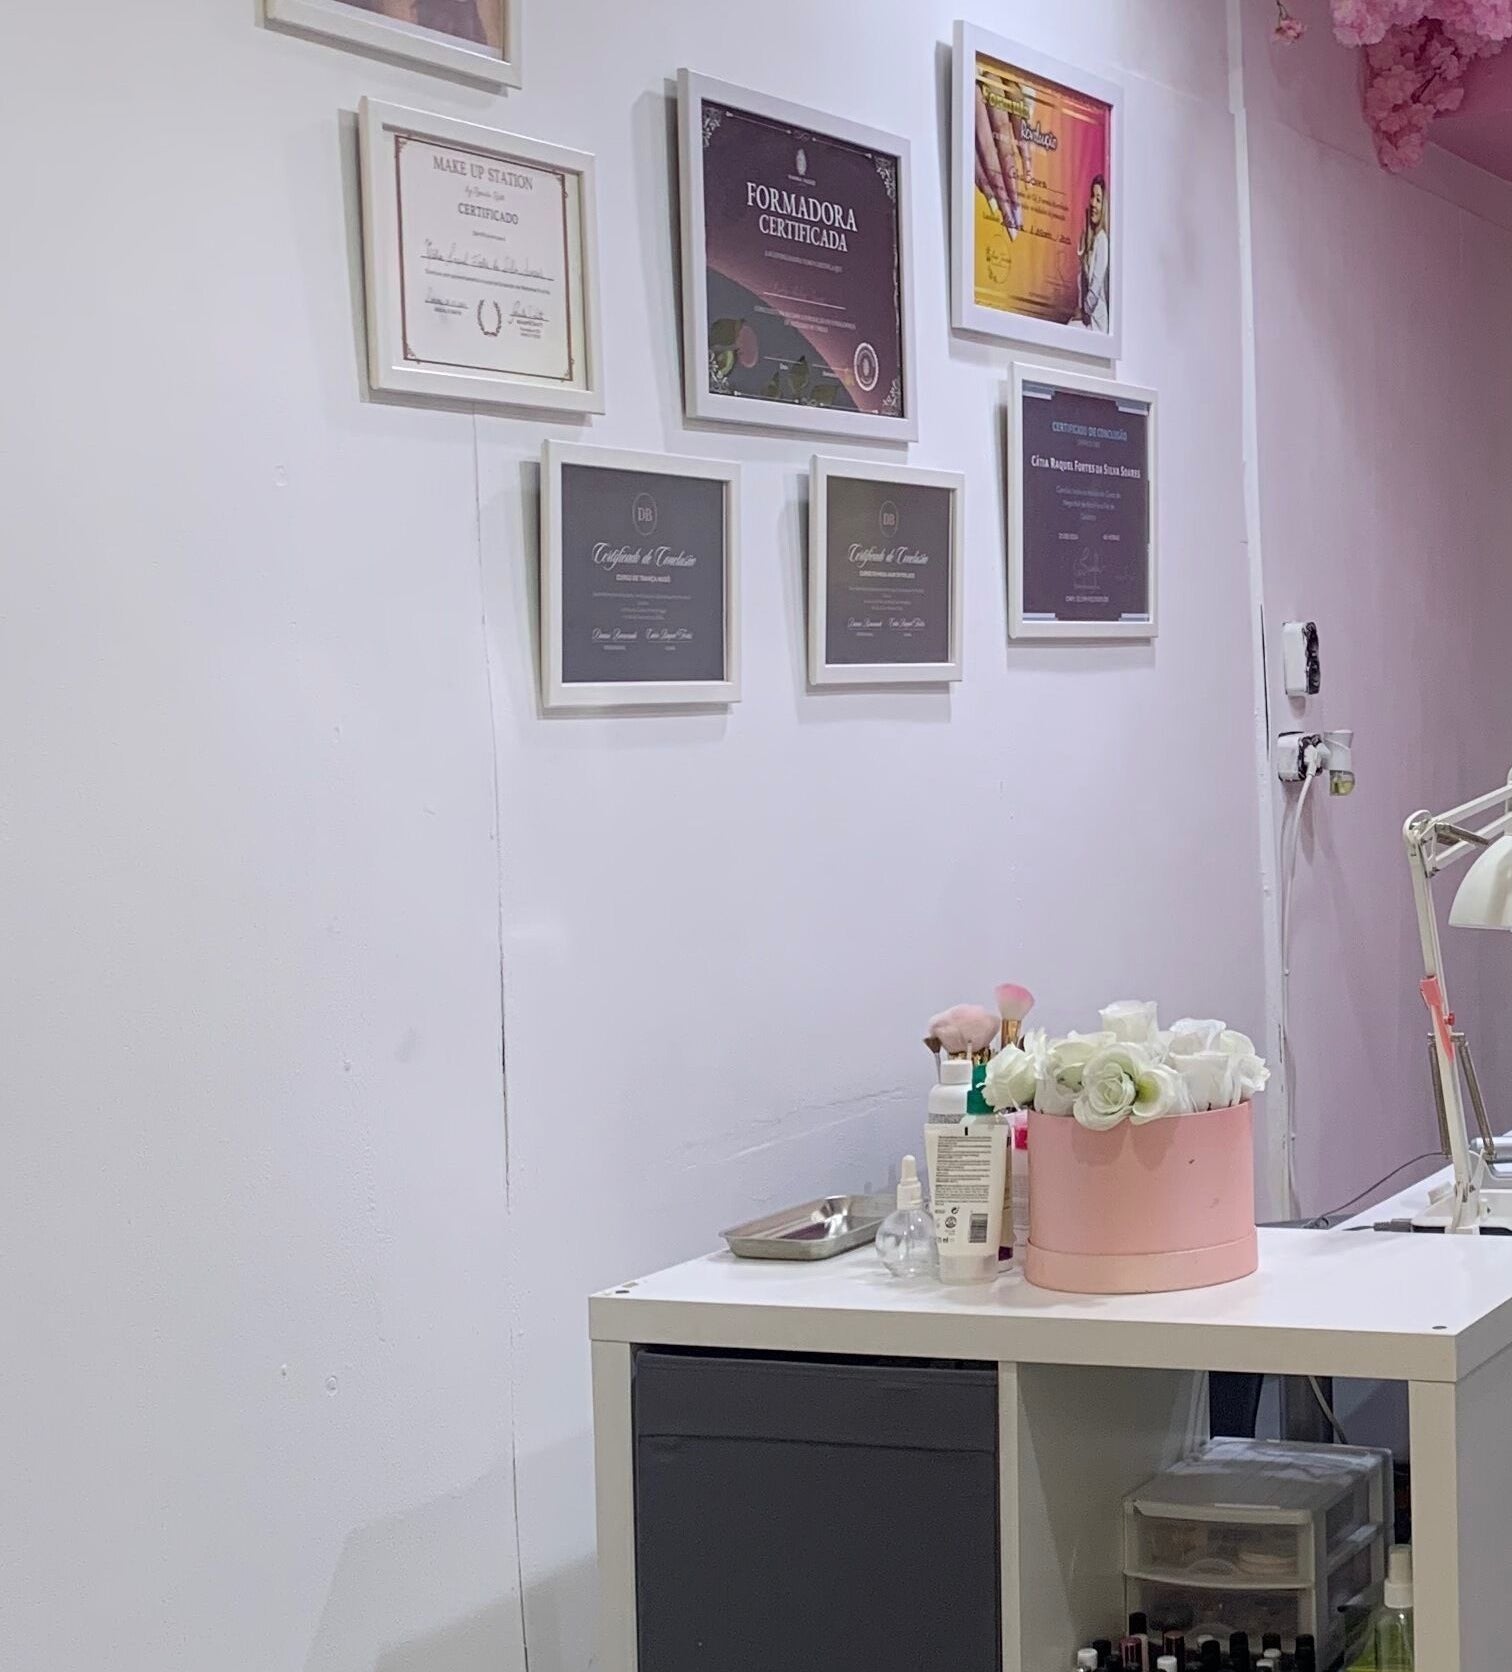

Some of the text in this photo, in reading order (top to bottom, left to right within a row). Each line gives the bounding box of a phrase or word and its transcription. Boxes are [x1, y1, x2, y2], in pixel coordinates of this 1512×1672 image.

[433, 155, 534, 190] MAKE UP STATION
[457, 202, 519, 225] CERTIFICADO
[746, 181, 858, 232] FORMADORA
[759, 214, 848, 252] CERTIFICADA
[637, 506, 653, 522] DB
[883, 512, 896, 526] DB
[592, 542, 642, 571] Certificado
[641, 549, 653, 565] de
